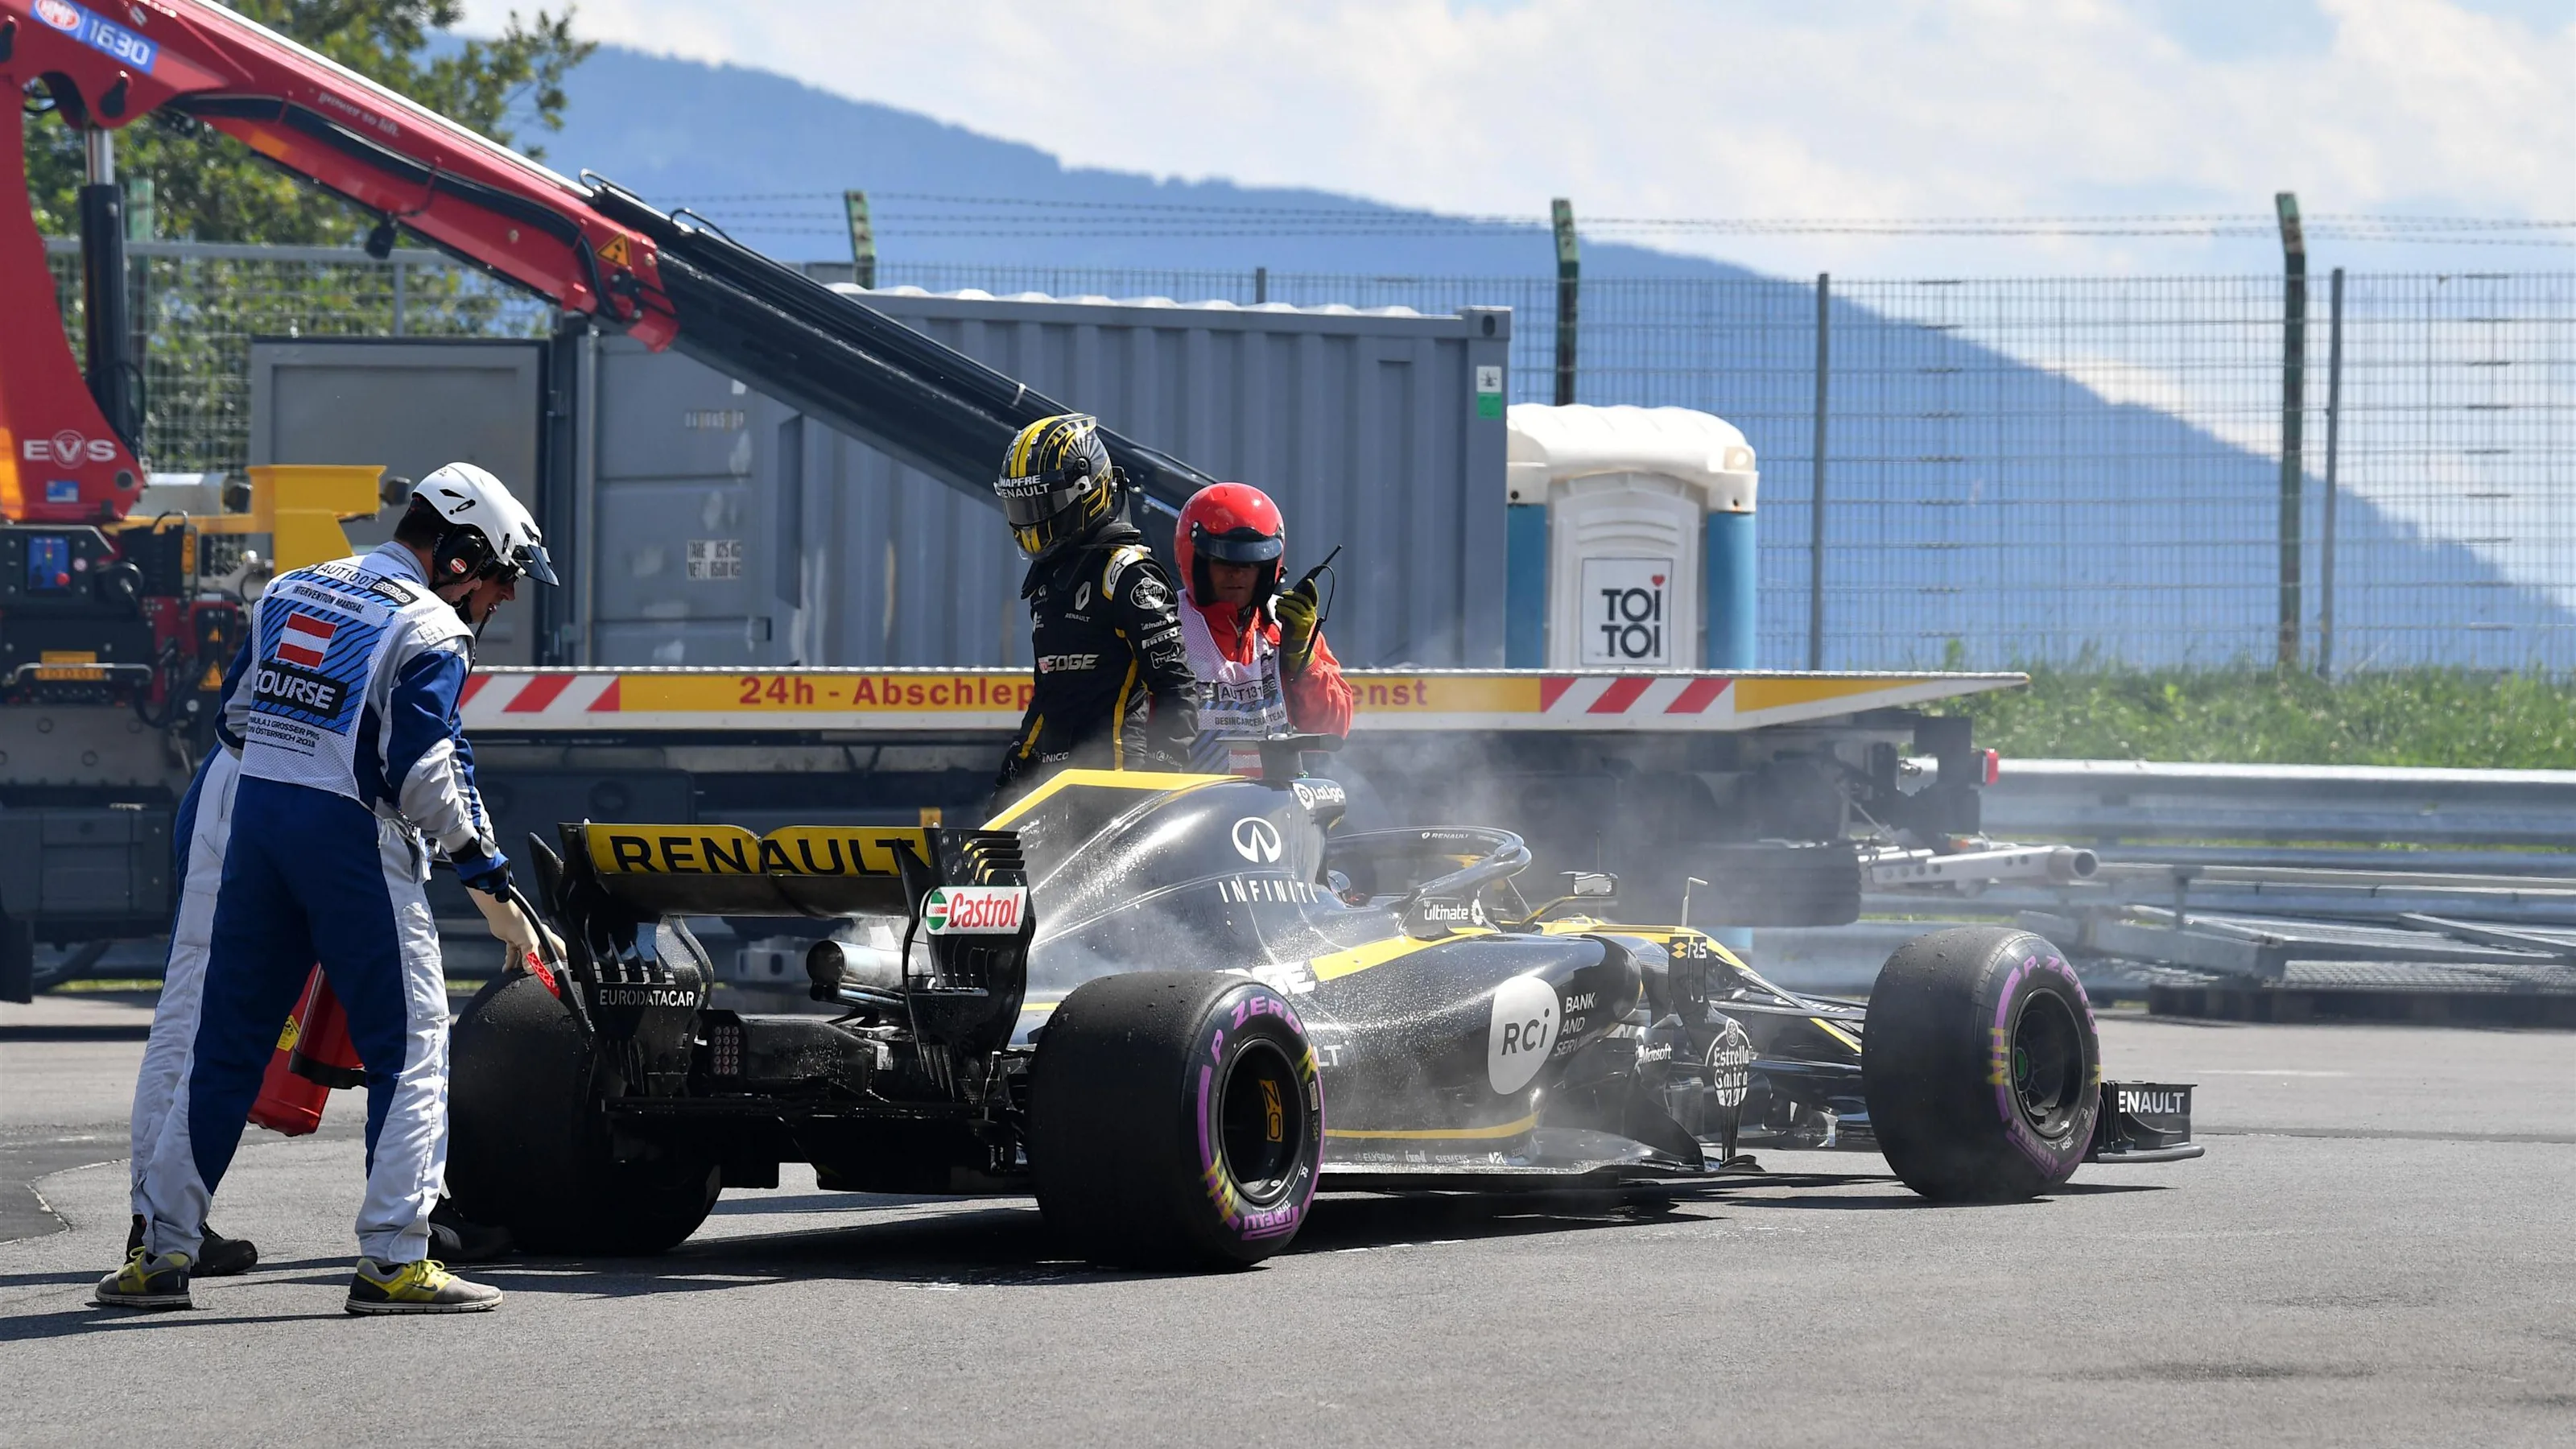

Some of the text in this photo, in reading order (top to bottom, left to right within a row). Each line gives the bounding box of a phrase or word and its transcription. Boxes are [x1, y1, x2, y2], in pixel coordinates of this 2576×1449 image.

[89, 19, 151, 65] 1630
[23, 439, 117, 462] EVS
[999, 474, 1041, 488] MAPFRE
[292, 585, 365, 614] INTERVENTION MARSHAL
[374, 581, 411, 603] 2018
[1064, 613, 1091, 623] RENAULT
[1600, 622, 1660, 658] TOI
[1046, 654, 1100, 671] EDGE
[739, 676, 814, 705] 24h
[270, 720, 306, 736] GROSSER
[1311, 784, 1345, 803] LaLiga
[609, 835, 916, 877] RENAULT
[1217, 879, 1319, 903] INFINITI
[948, 891, 1020, 929] Castrol
[1424, 903, 1468, 921] ultimate
[599, 989, 694, 1007] EURODATACAR
[1565, 992, 1596, 1013] BANK
[1231, 996, 1302, 1035] ZERO
[1560, 1017, 1586, 1036] AND
[1501, 1008, 1550, 1055] RCi
[1713, 1045, 1750, 1067] Estrella
[1435, 1154, 1470, 1163] SIEMENS
[1241, 1206, 1299, 1241] PIRELLI
